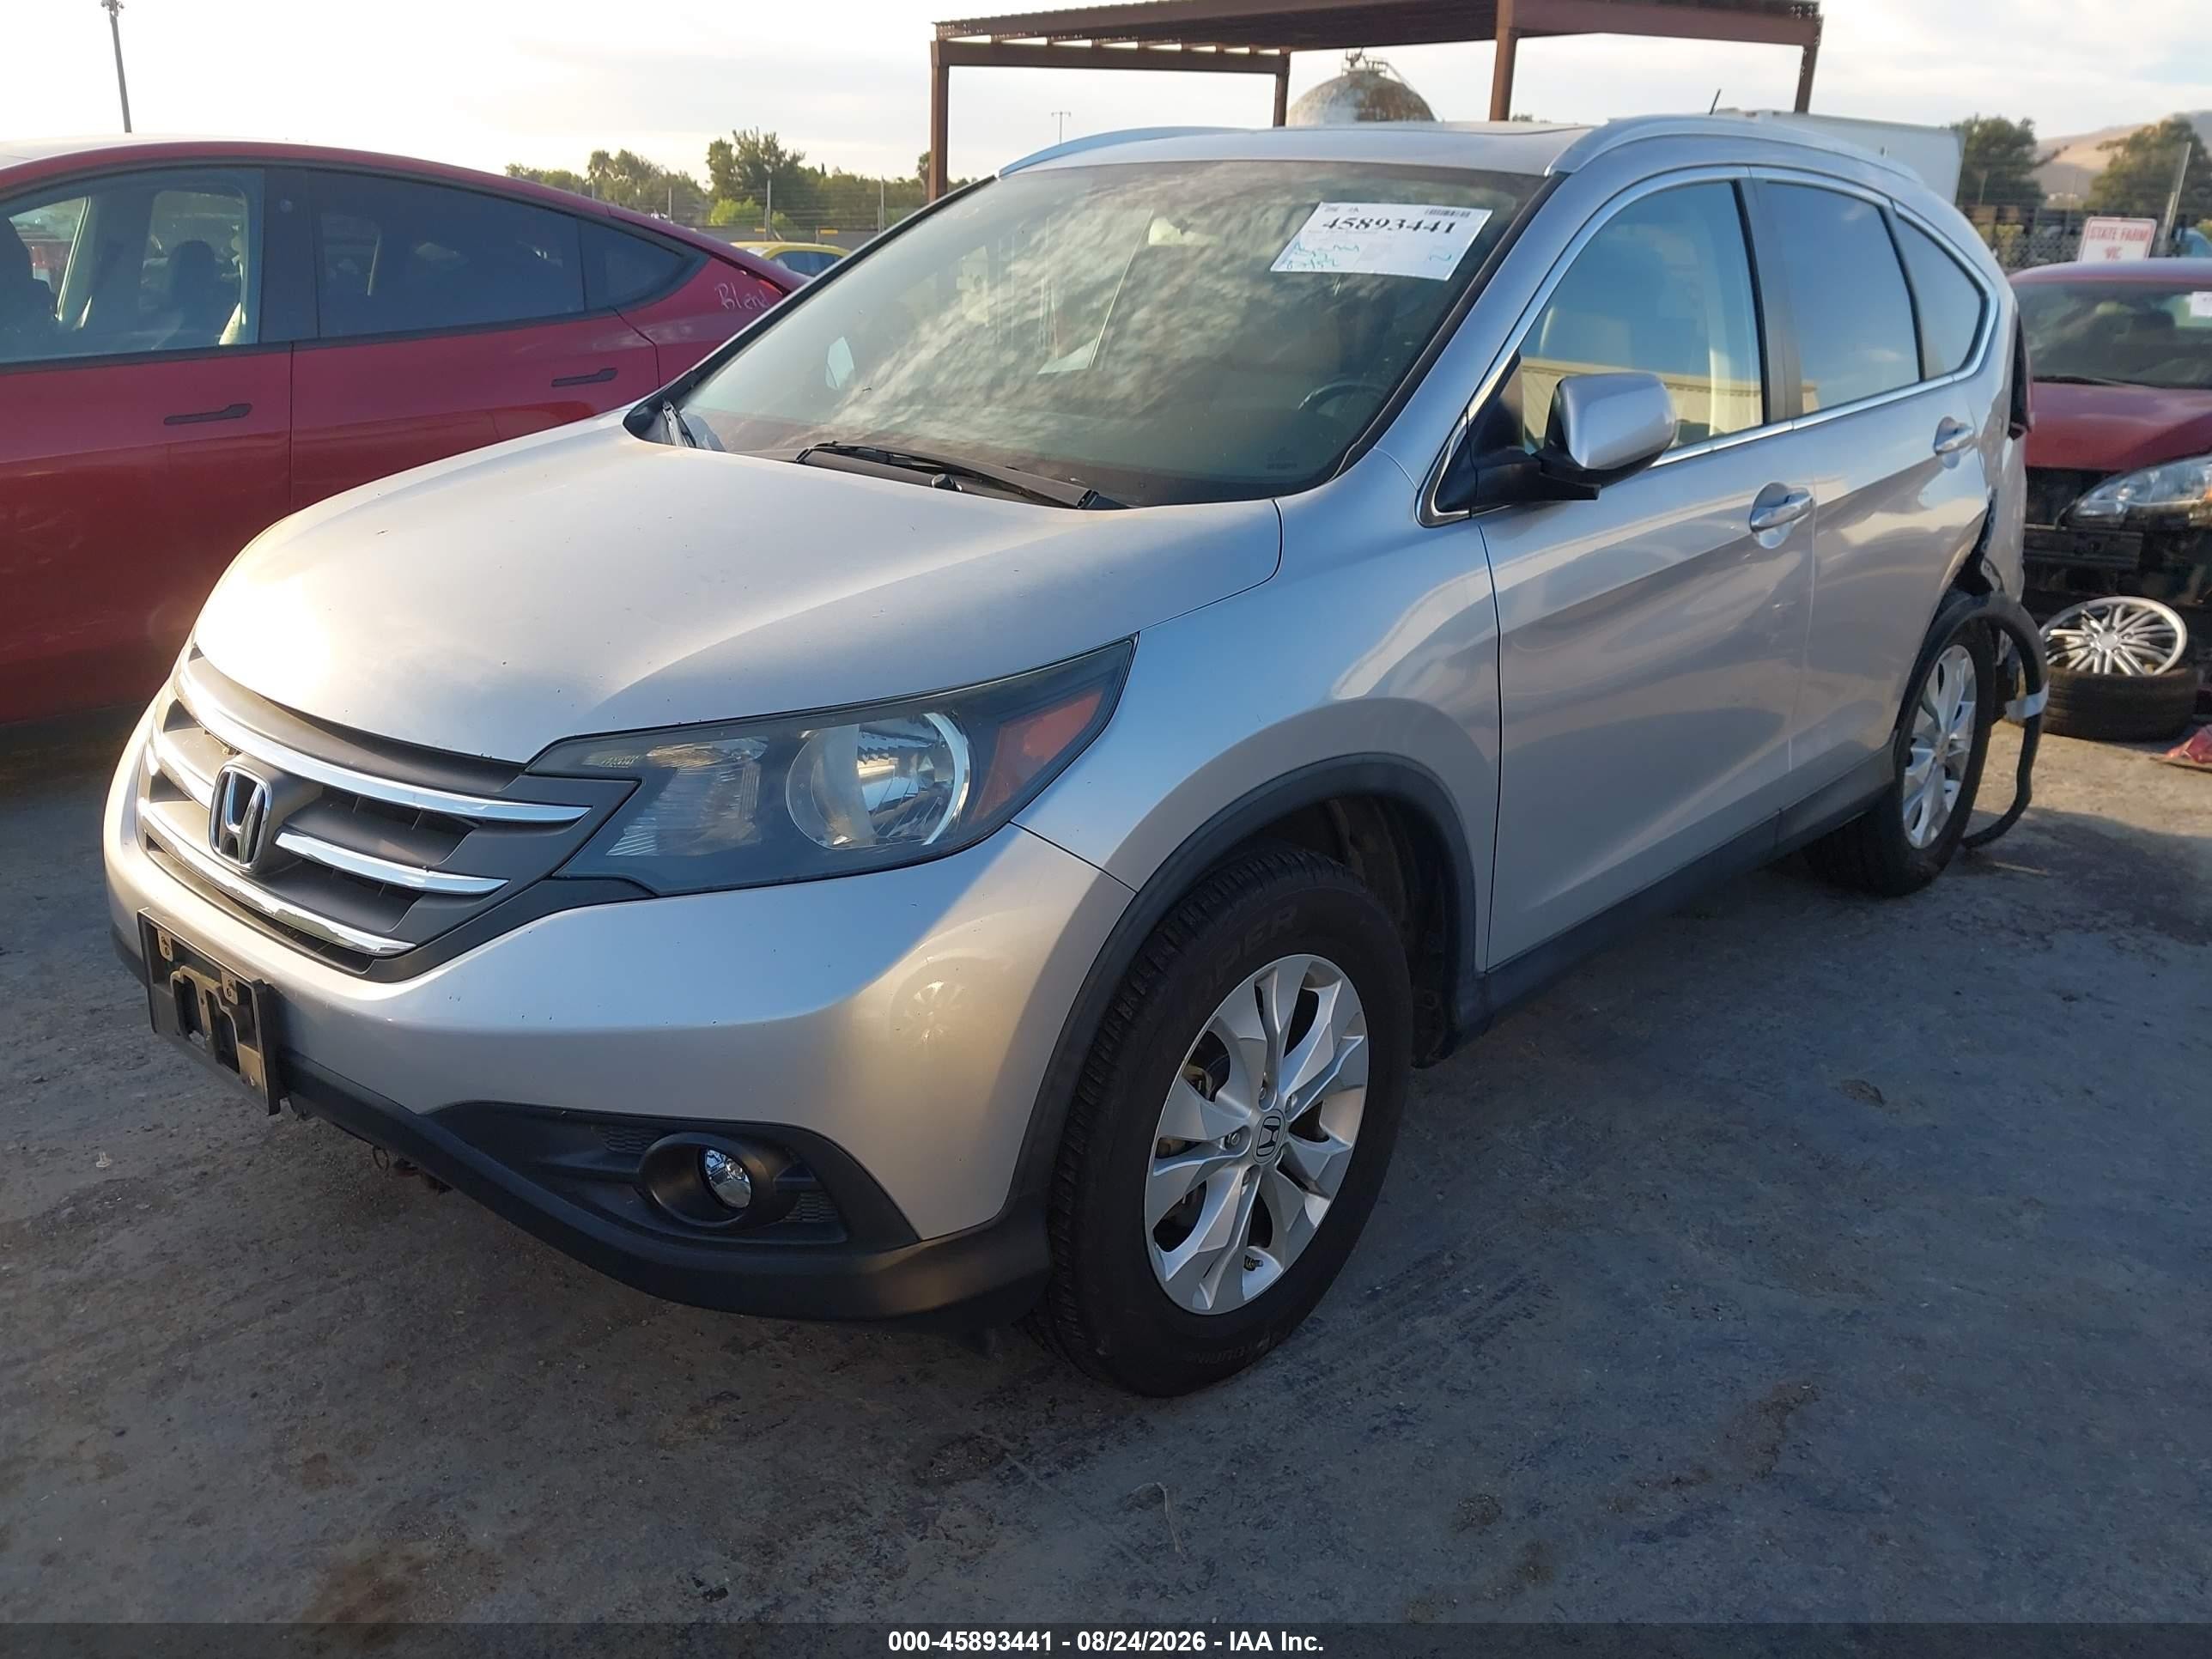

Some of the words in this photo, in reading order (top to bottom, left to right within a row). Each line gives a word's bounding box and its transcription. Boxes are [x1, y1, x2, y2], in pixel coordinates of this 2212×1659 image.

[1322, 216, 1455, 234] 45893441
[2088, 227, 2117, 240] STATE
[2121, 228, 2150, 240] FARM
